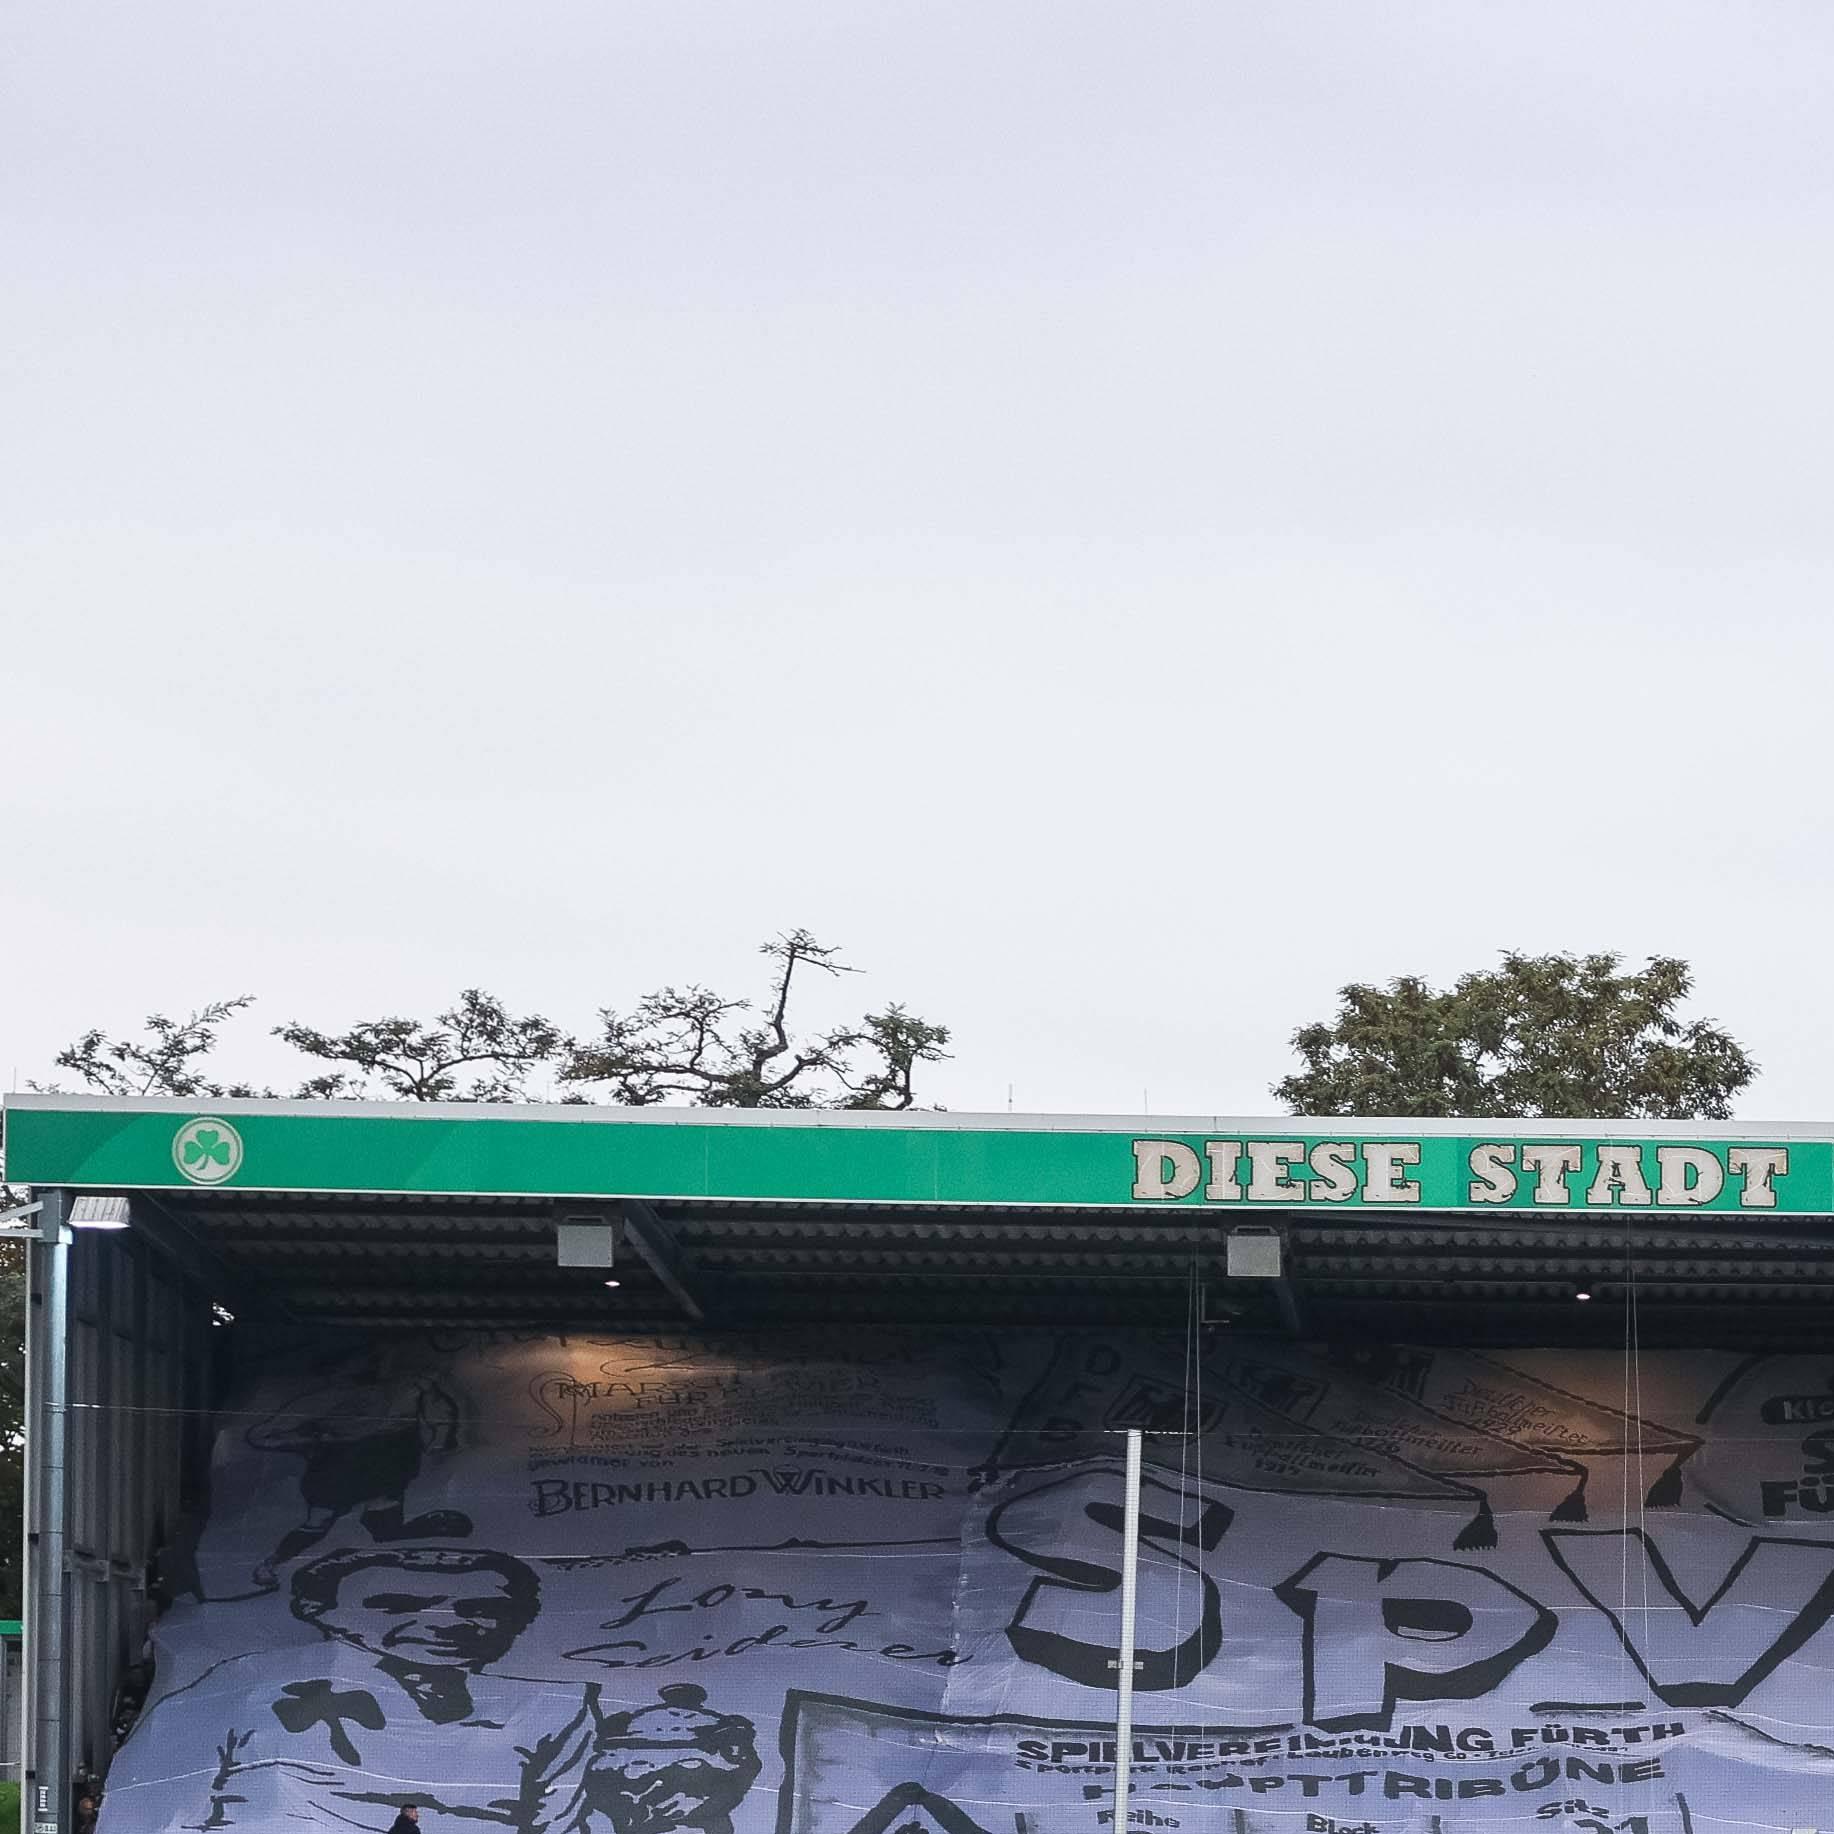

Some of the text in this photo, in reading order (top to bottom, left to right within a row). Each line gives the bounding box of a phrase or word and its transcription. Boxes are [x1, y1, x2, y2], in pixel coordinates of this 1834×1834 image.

[1131, 1139, 1422, 1203] DIESE
[1468, 1143, 1789, 1207] STADT
[529, 1463, 946, 1517] BERNHARD WINKLER
[1510, 1722, 1687, 1751] FÜRTH
